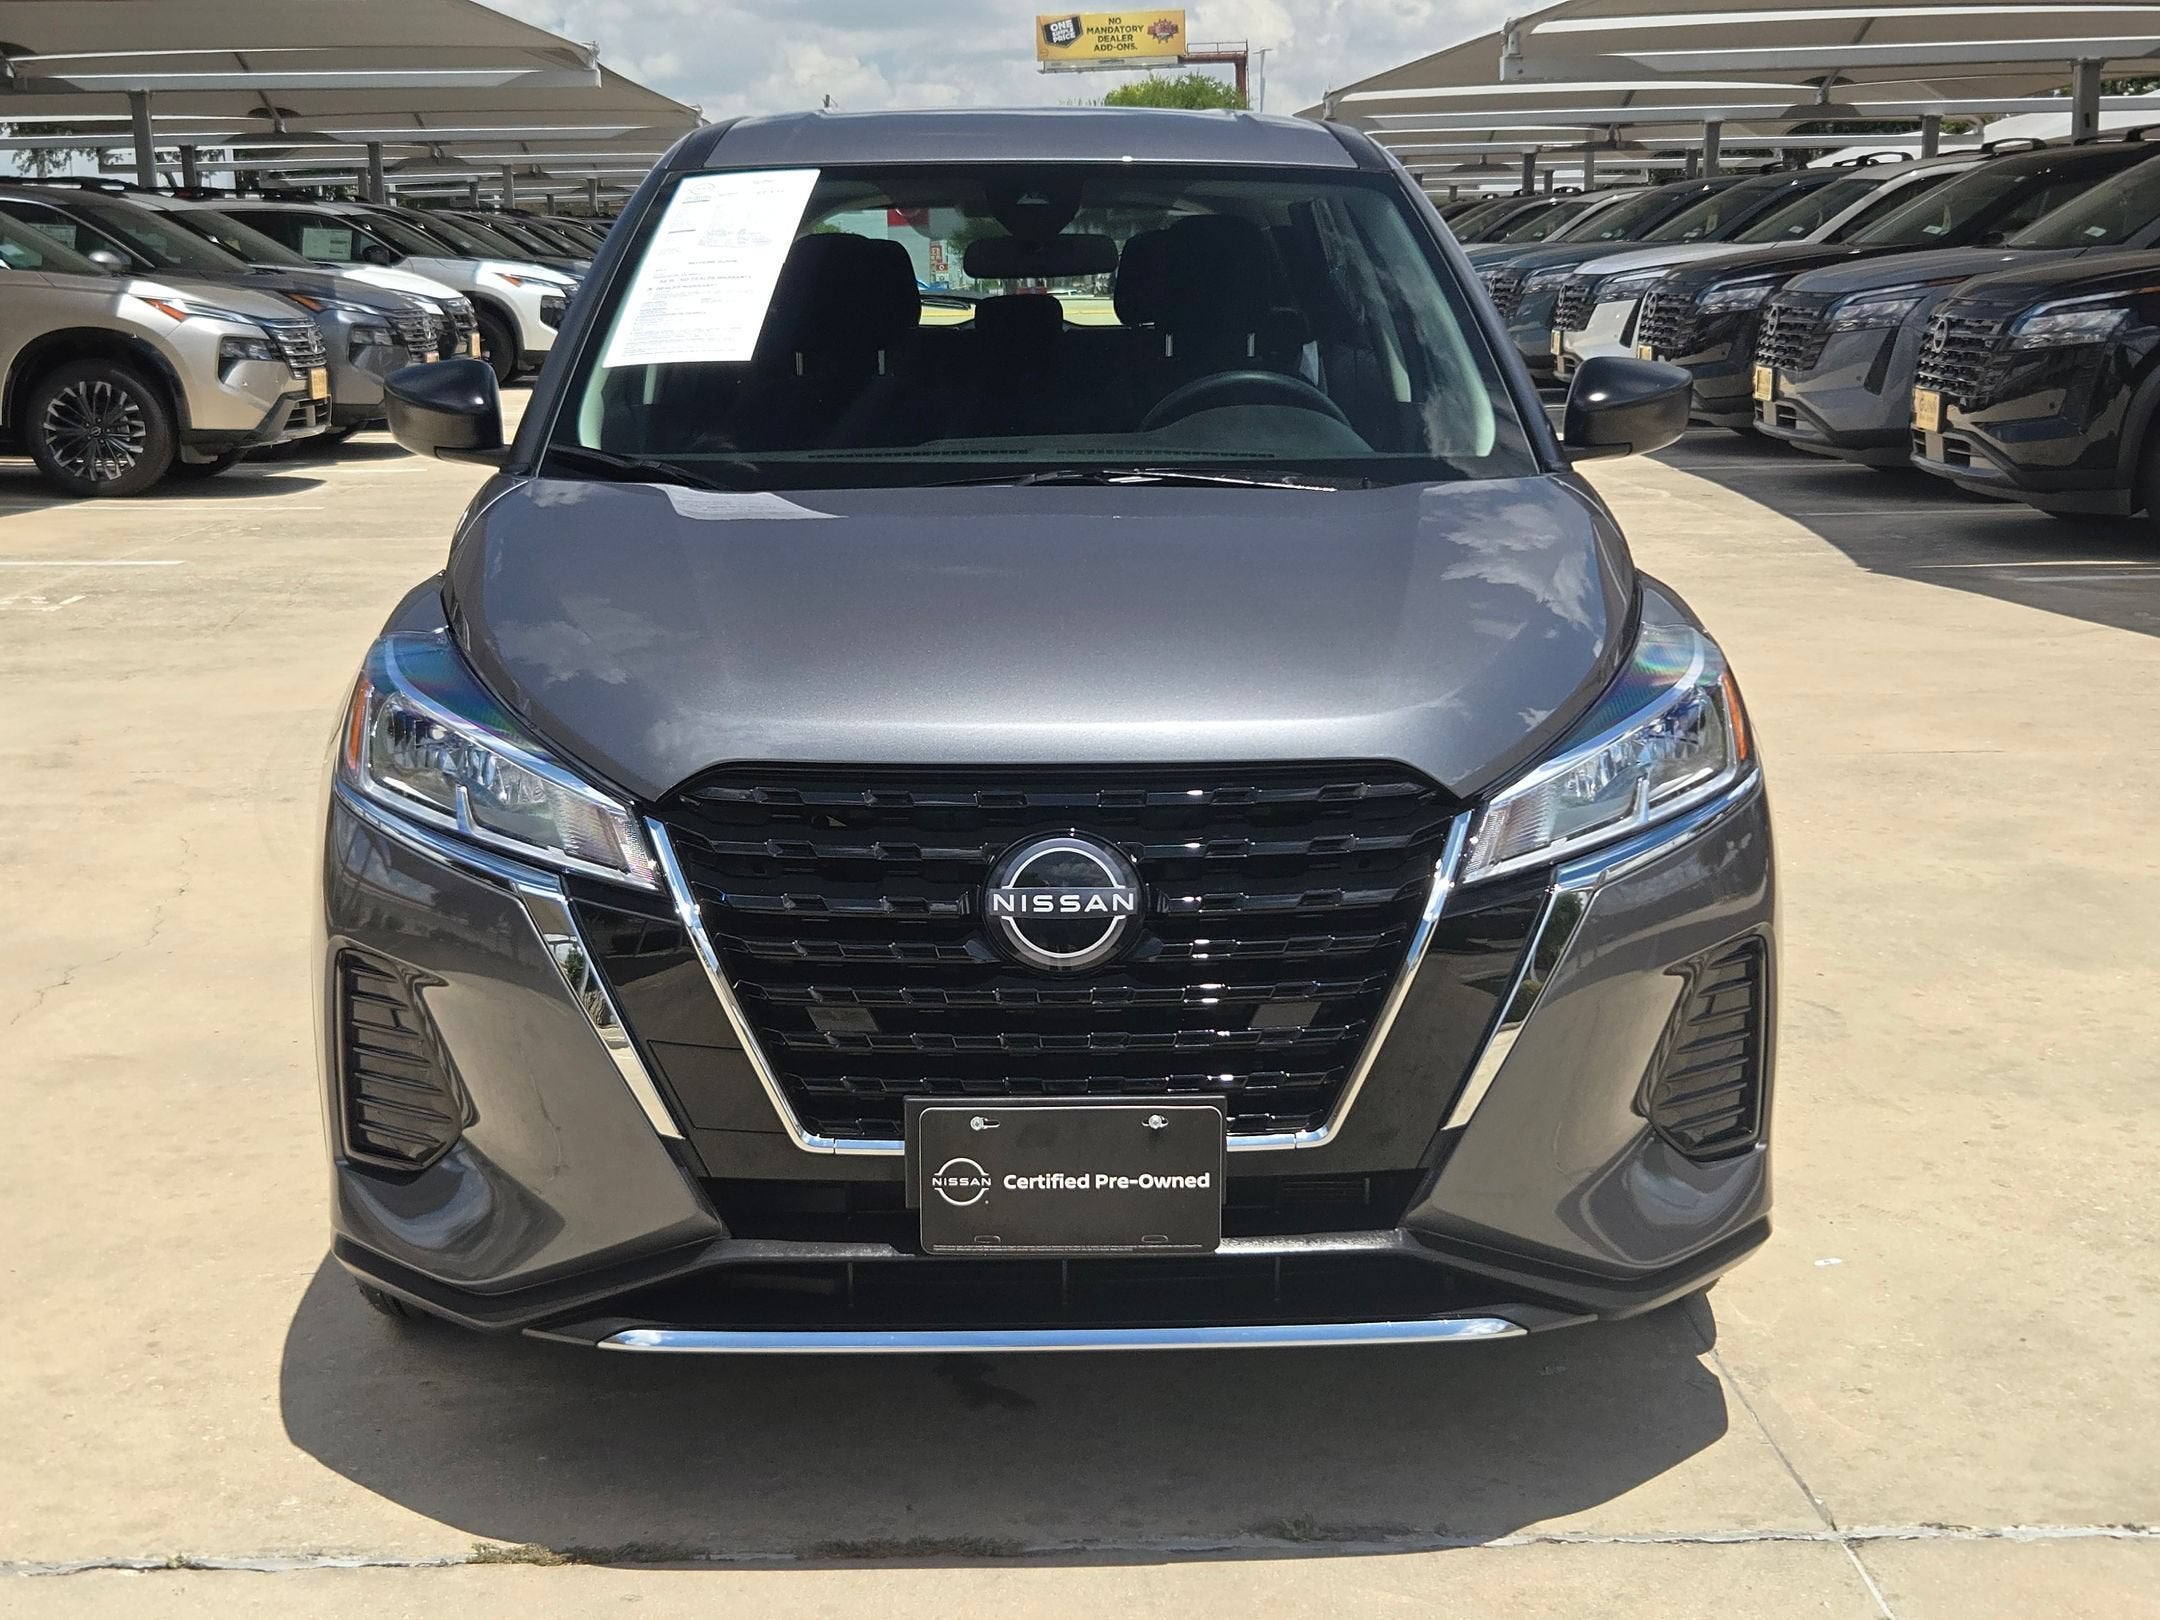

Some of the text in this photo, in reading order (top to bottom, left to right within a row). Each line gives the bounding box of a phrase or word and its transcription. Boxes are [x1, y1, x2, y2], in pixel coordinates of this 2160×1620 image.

[1050, 20, 1073, 31] ONE
[1108, 17, 1122, 25] NO
[1087, 25, 1144, 34] MANDATORY
[1052, 32, 1076, 42] PRICE
[1098, 34, 1133, 42] DEALER
[1094, 43, 1138, 52] ADD-ONS.
[993, 893, 1134, 912] NISSAN
[931, 1176, 992, 1187] NISSAN
[1003, 1172, 1211, 1189] Certified Pre-Owned
